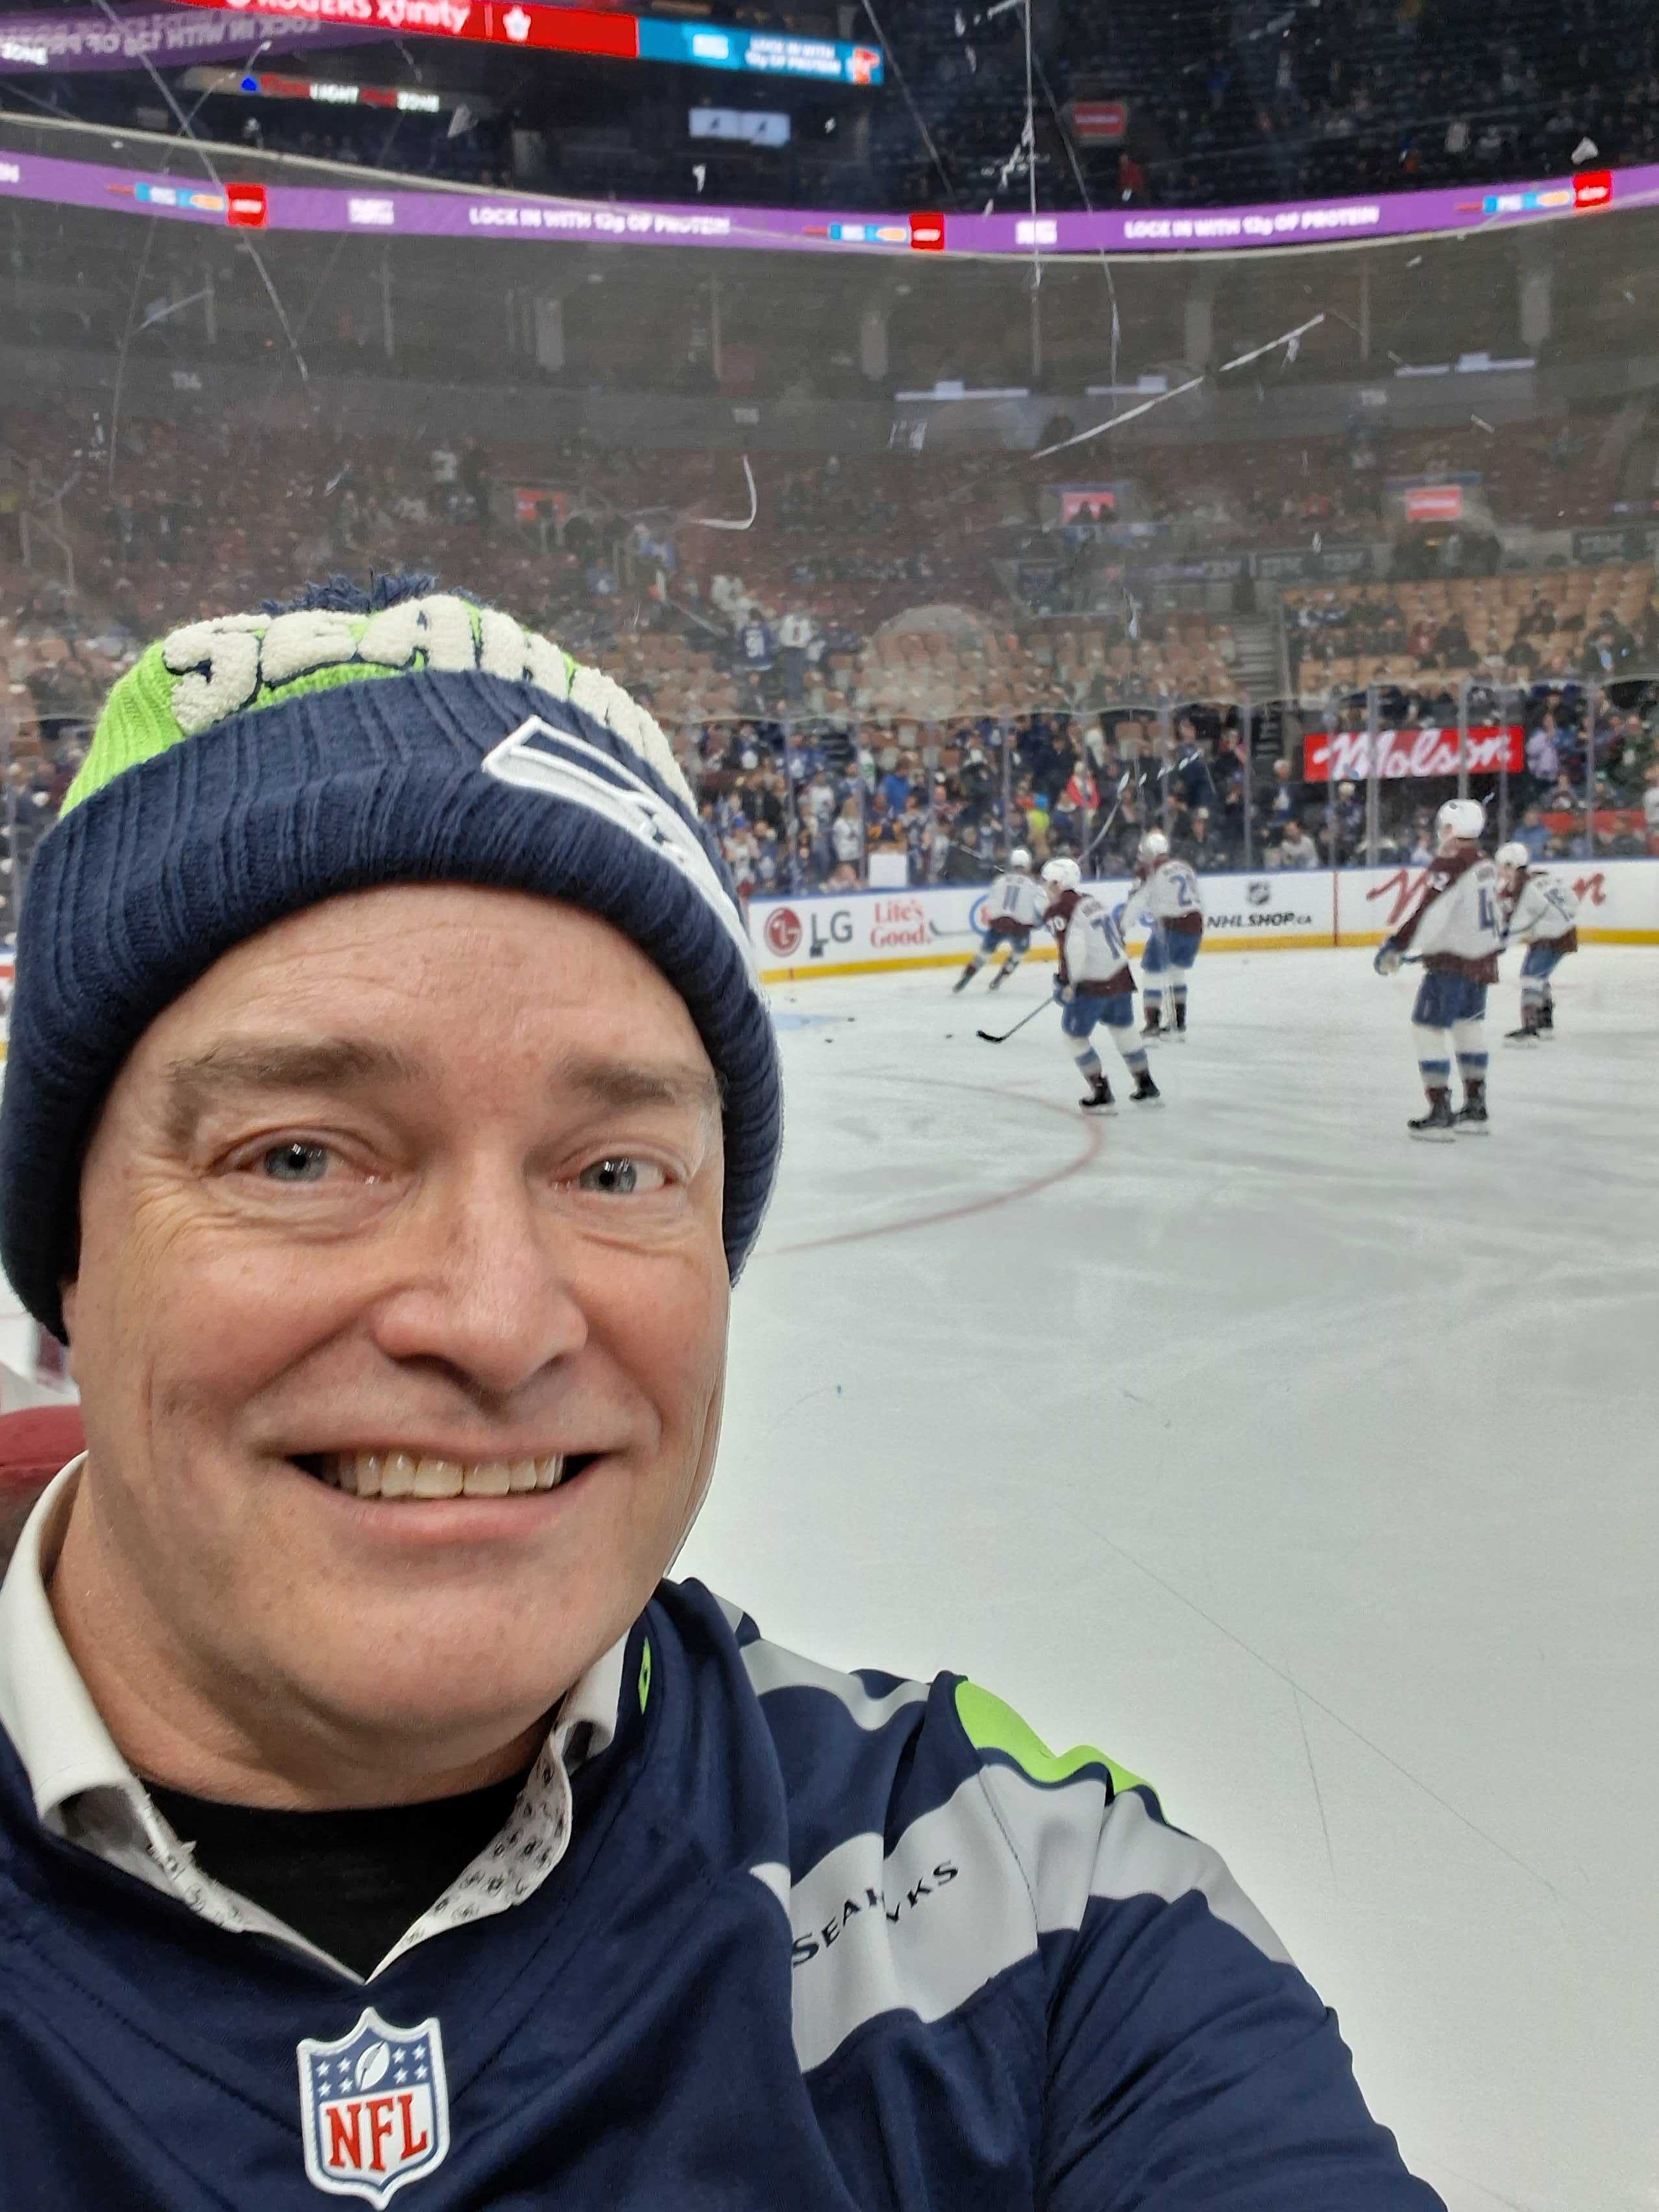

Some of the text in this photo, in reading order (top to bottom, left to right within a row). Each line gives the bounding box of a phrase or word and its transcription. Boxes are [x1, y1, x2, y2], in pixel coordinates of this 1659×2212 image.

[1312, 728, 1512, 780] Molson
[810, 910, 854, 946] LG
[874, 898, 926, 924] Life's
[326, 2092, 428, 2172] NFL
